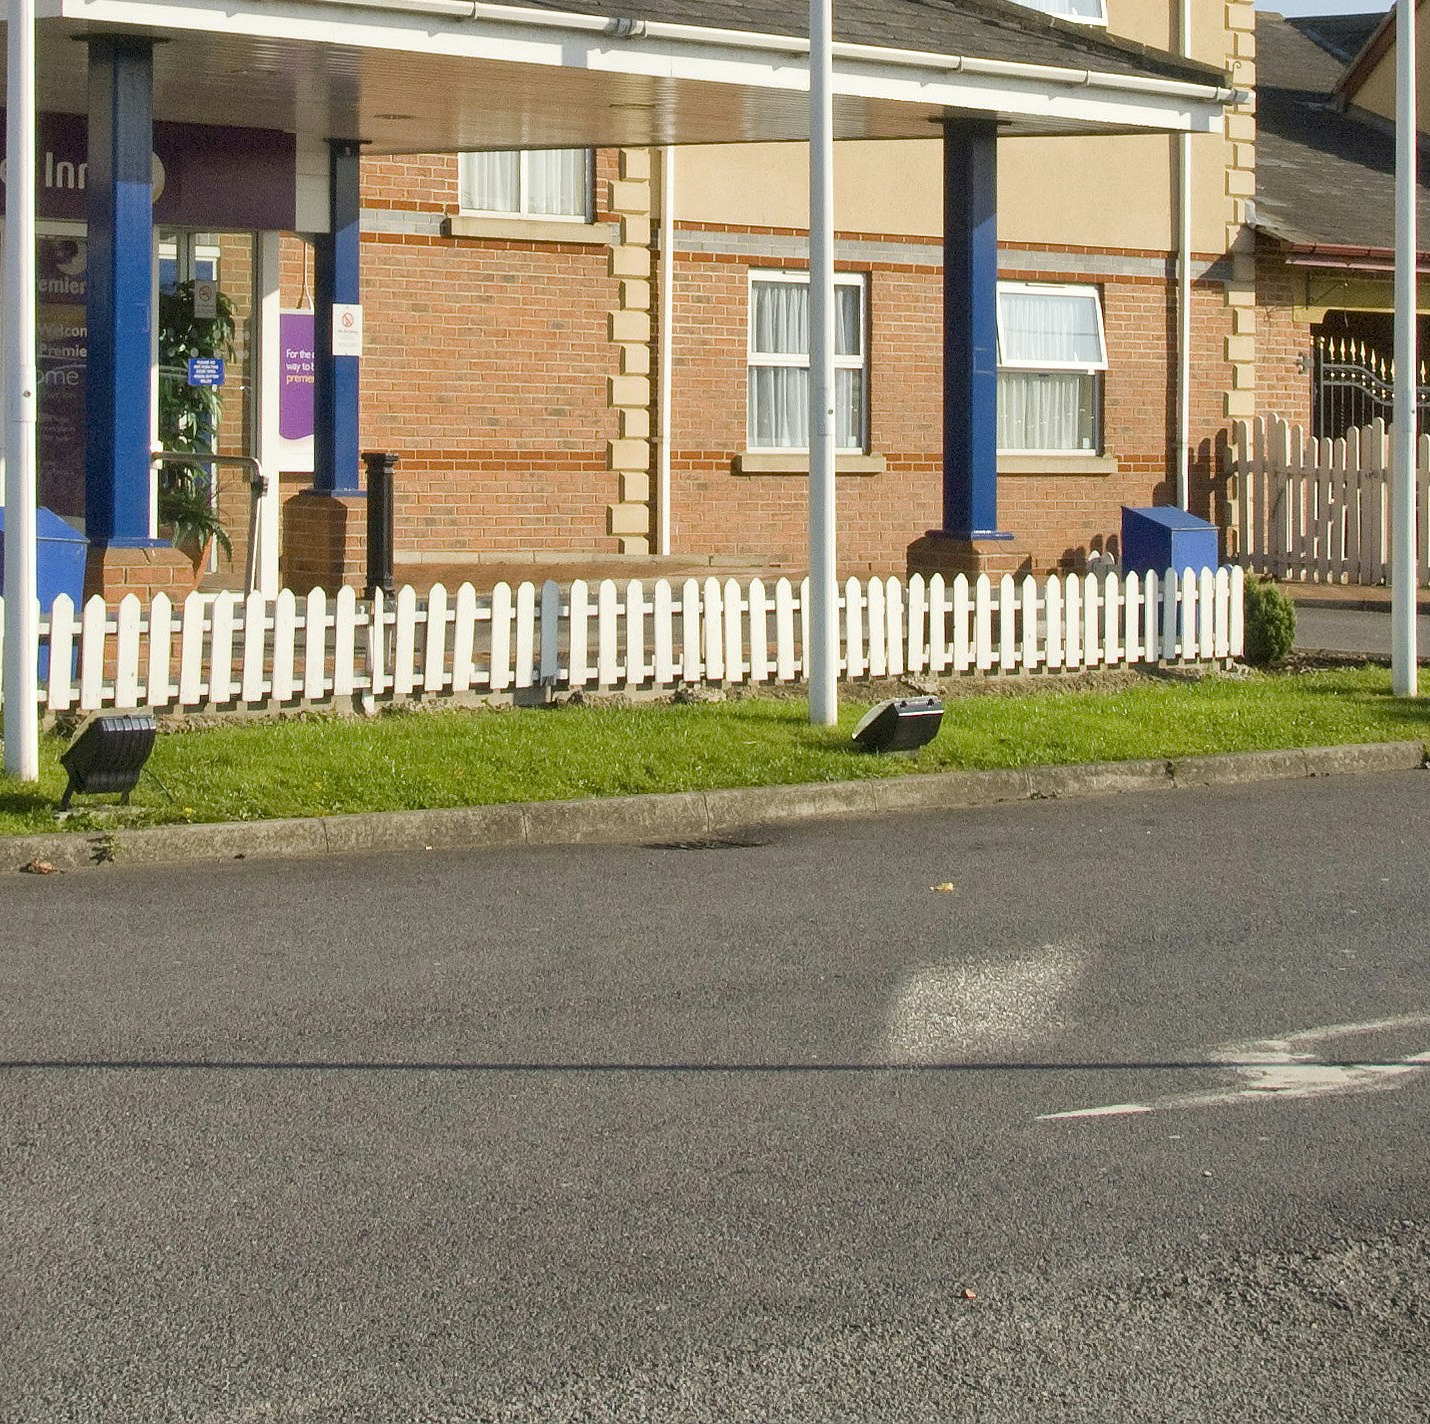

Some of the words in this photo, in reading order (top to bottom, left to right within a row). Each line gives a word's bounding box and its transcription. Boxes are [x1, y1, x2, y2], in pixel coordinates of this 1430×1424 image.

[37, 277, 87, 295] emier
[39, 343, 87, 358] Premie
[286, 348, 298, 359] For
[299, 349, 311, 359] the
[285, 363, 301, 374] way
[302, 362, 310, 371] to
